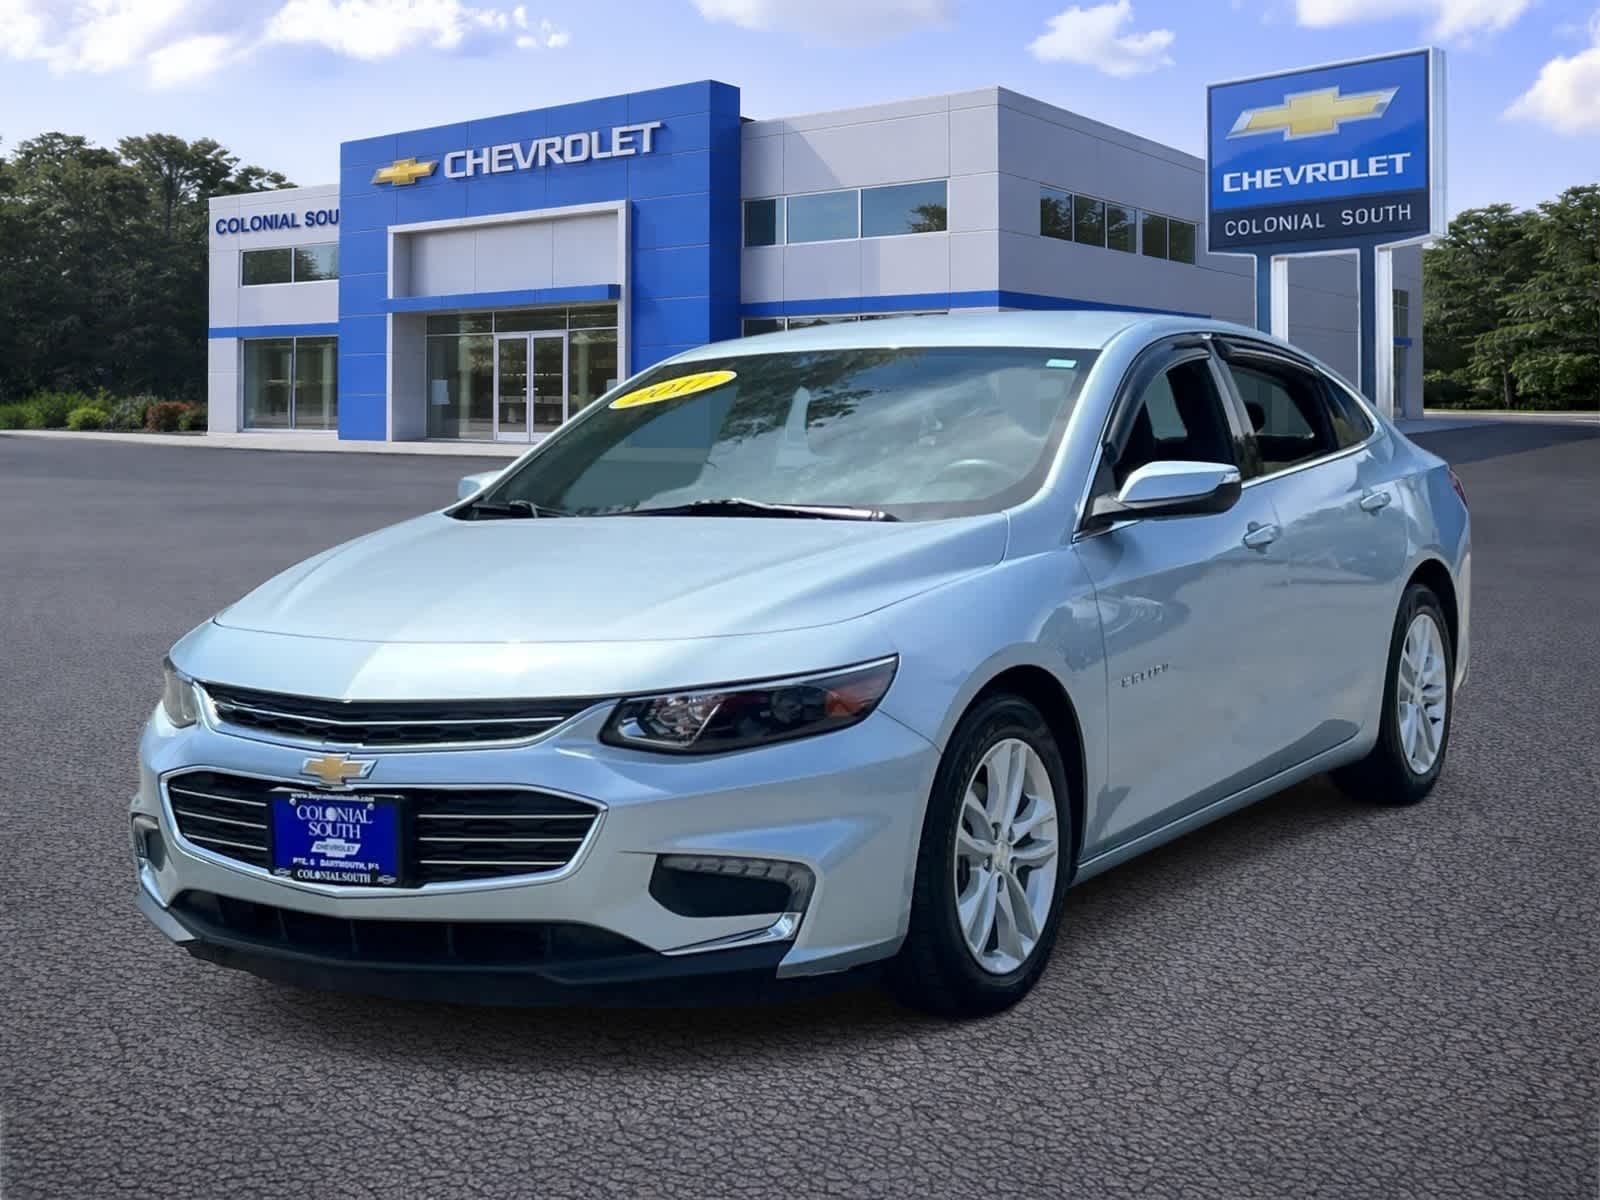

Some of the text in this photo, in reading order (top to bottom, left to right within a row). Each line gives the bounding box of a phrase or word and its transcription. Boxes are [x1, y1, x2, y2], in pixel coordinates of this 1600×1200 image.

[443, 121, 664, 179] CHEVROLET
[1222, 152, 1412, 192] CHEVROLET
[215, 211, 300, 235] COLONIAL
[1224, 203, 1412, 237] COLONIAL SOUTH
[296, 804, 374, 824] COLONIAL
[308, 821, 361, 839] SOUTH
[342, 872, 371, 883] SOUTH
